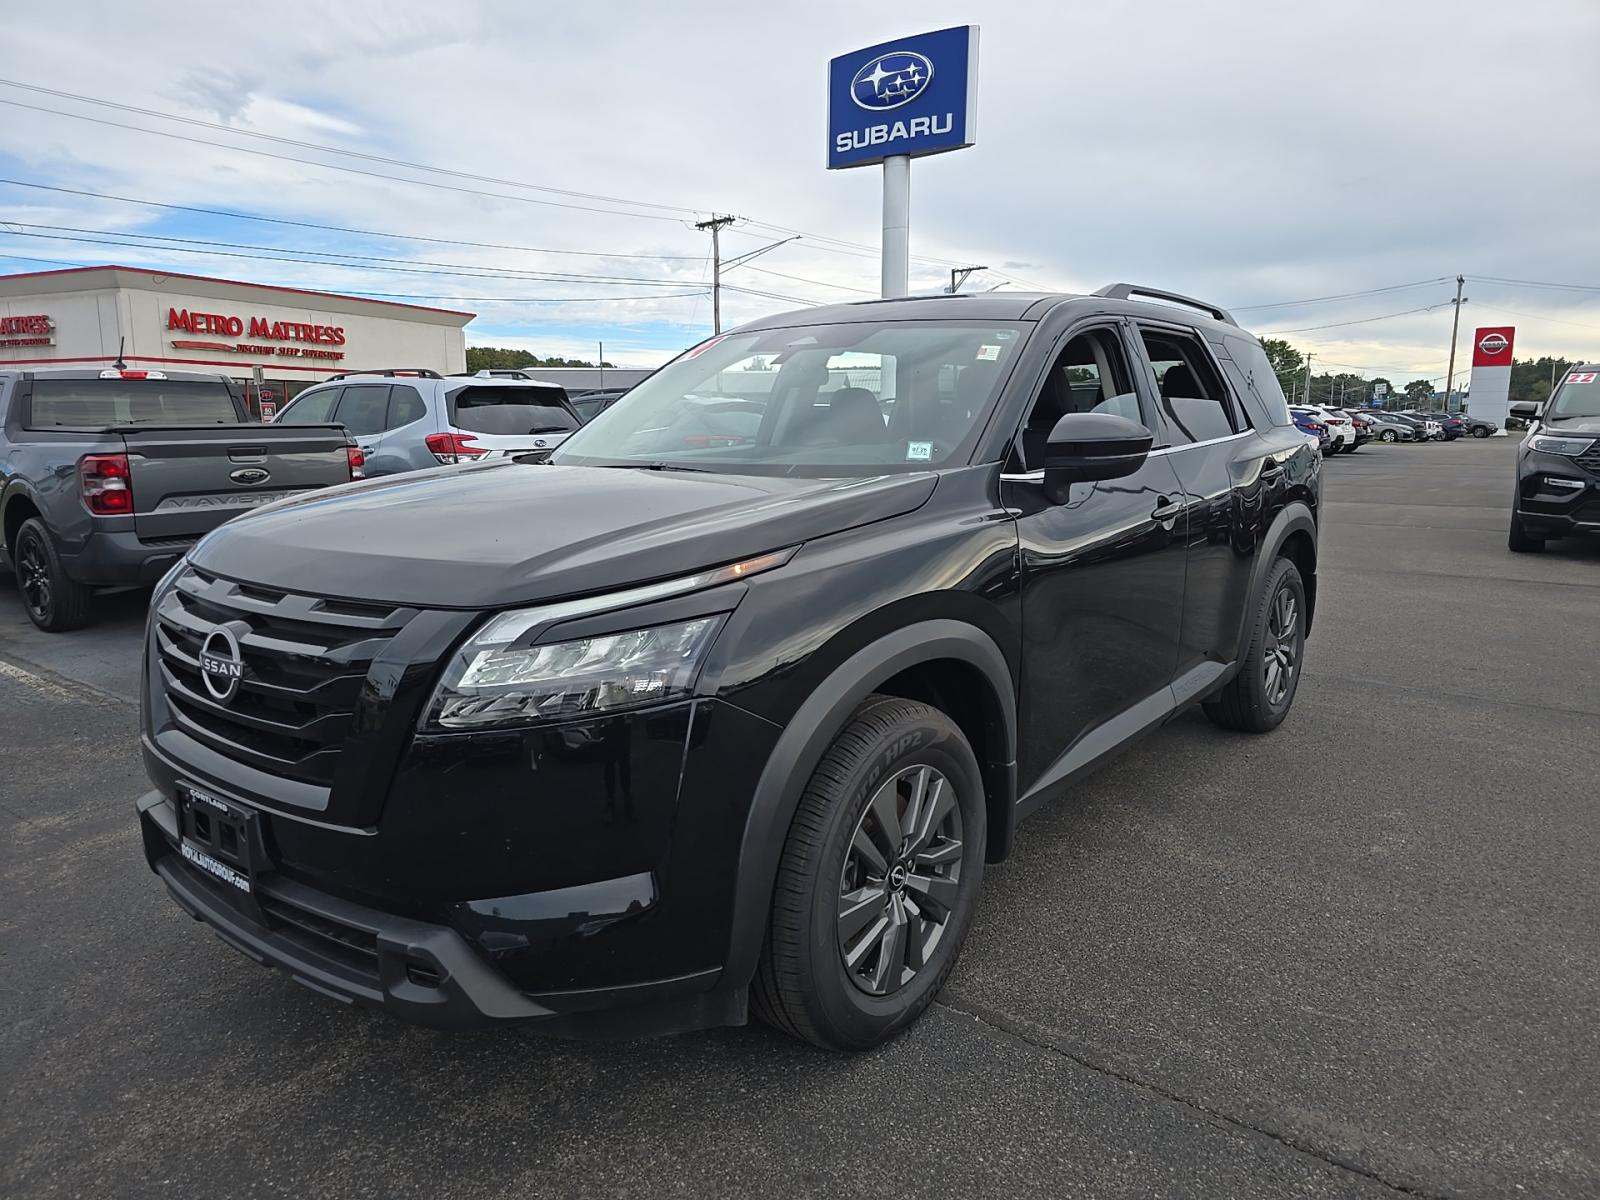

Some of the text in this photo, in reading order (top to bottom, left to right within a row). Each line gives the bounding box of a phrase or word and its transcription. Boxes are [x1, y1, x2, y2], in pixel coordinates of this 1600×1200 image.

[836, 113, 953, 153] SUBARU
[168, 307, 346, 346] METRO MATTRESS
[1569, 374, 1595, 383] 22
